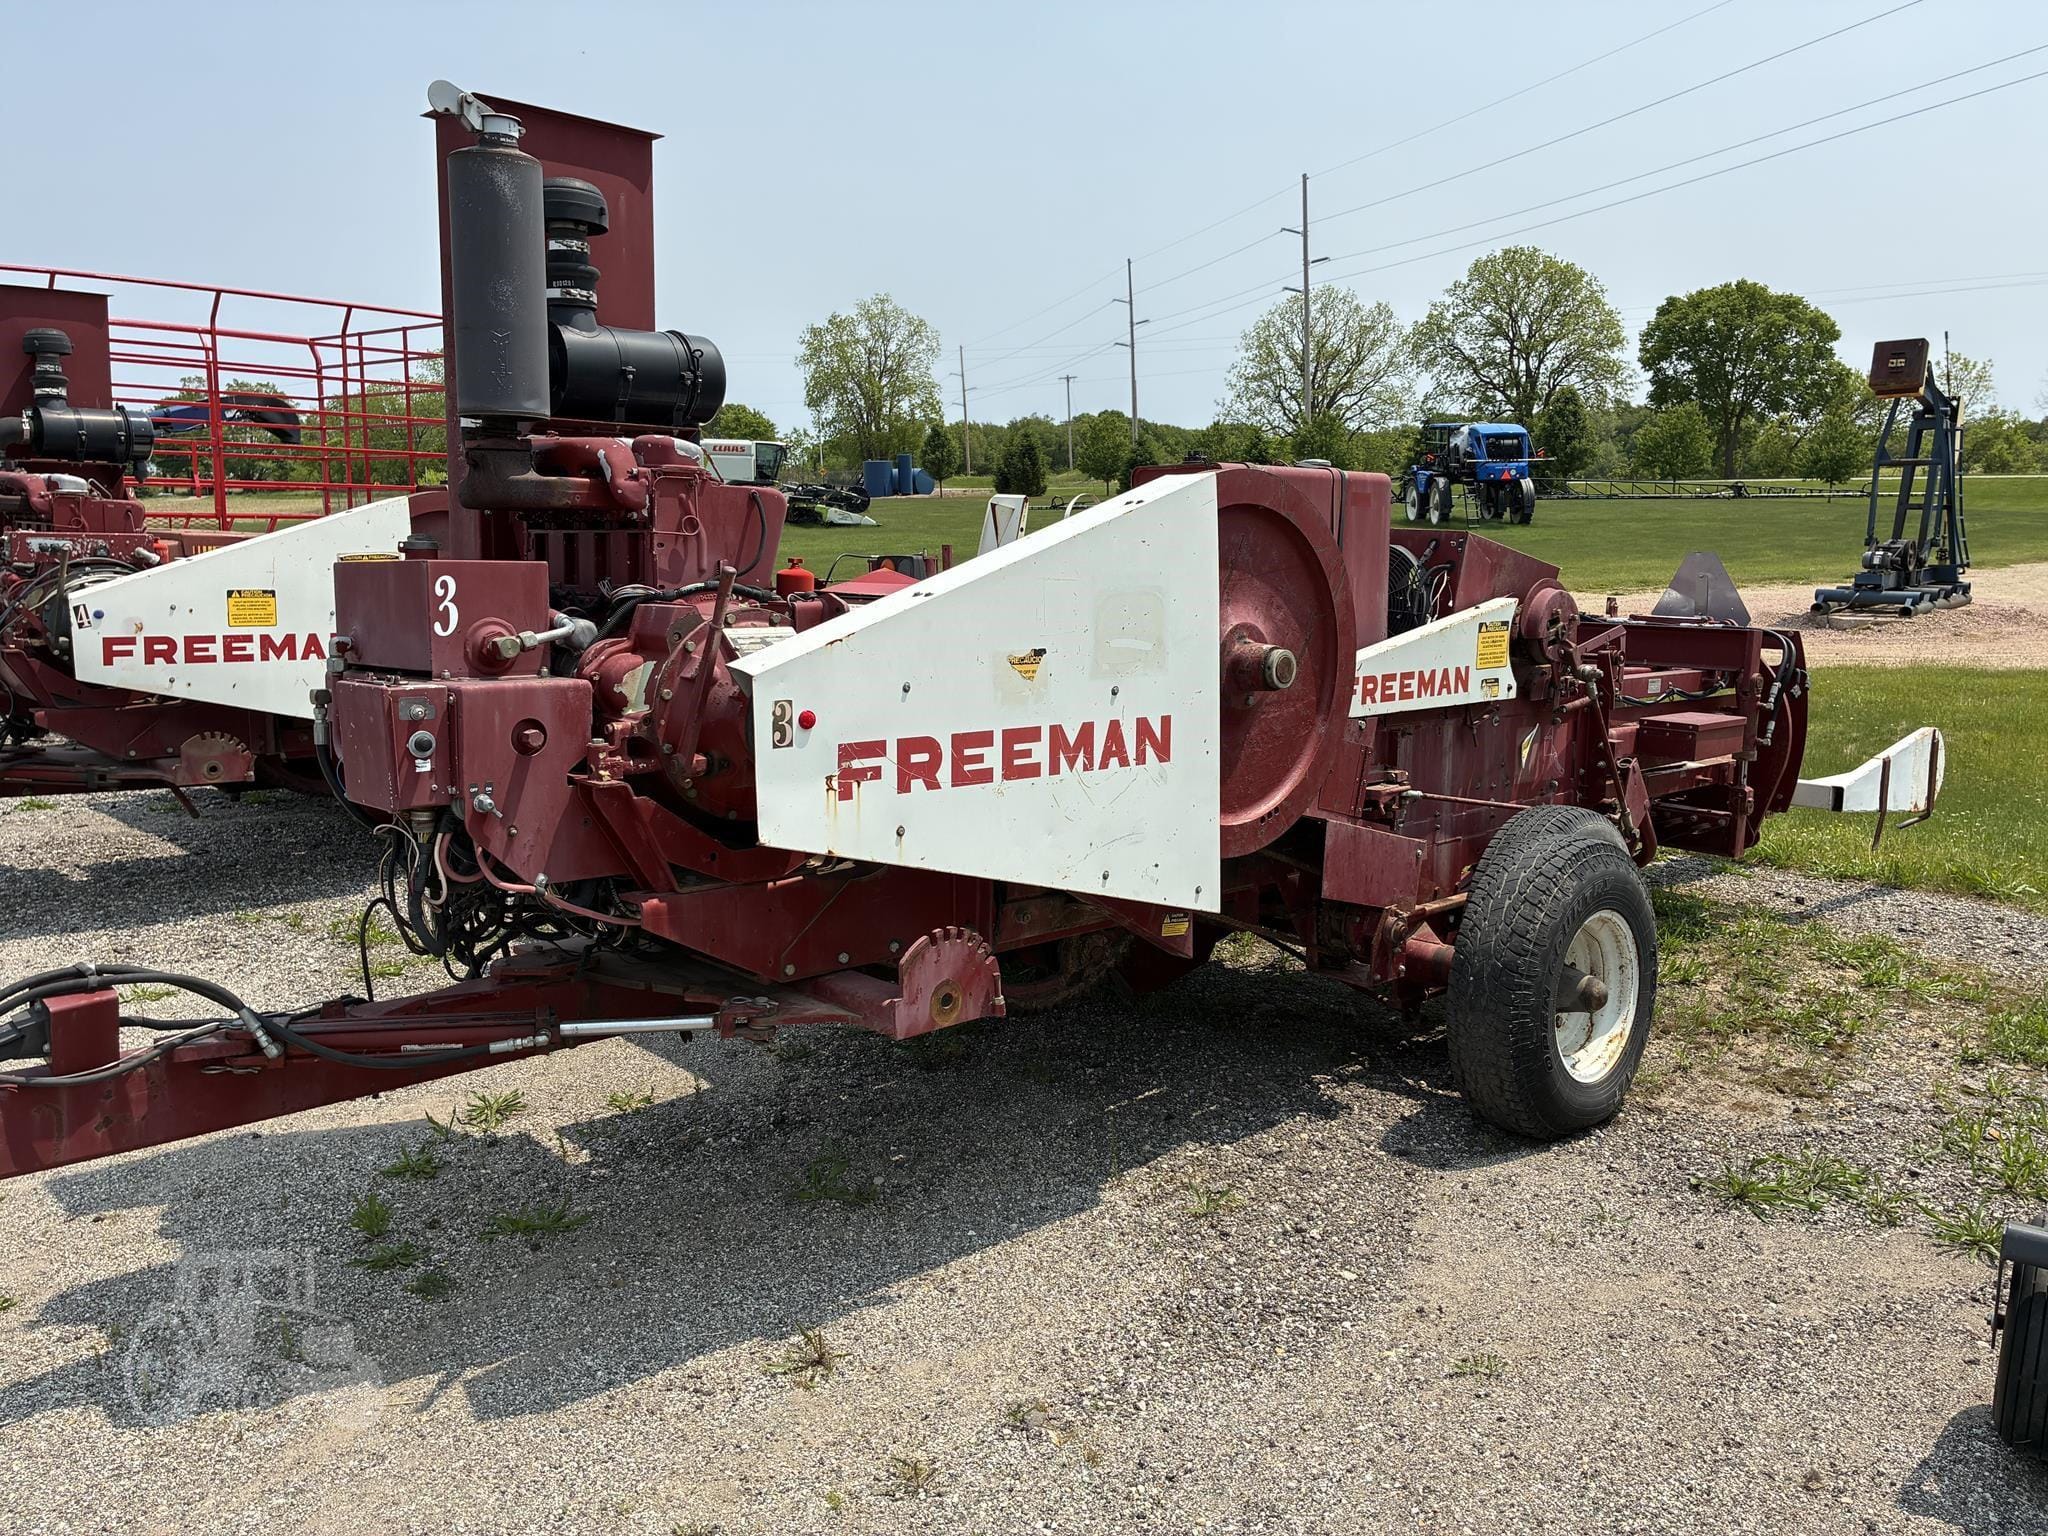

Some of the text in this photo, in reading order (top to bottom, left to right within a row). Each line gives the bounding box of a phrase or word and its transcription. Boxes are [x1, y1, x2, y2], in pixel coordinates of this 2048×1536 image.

[712, 444, 746, 453] CLAAS
[77, 604, 91, 628] 4
[434, 574, 459, 637] 3
[103, 633, 337, 666] FREEMA
[773, 701, 793, 747] 3
[838, 714, 1172, 801] FREEMAN
